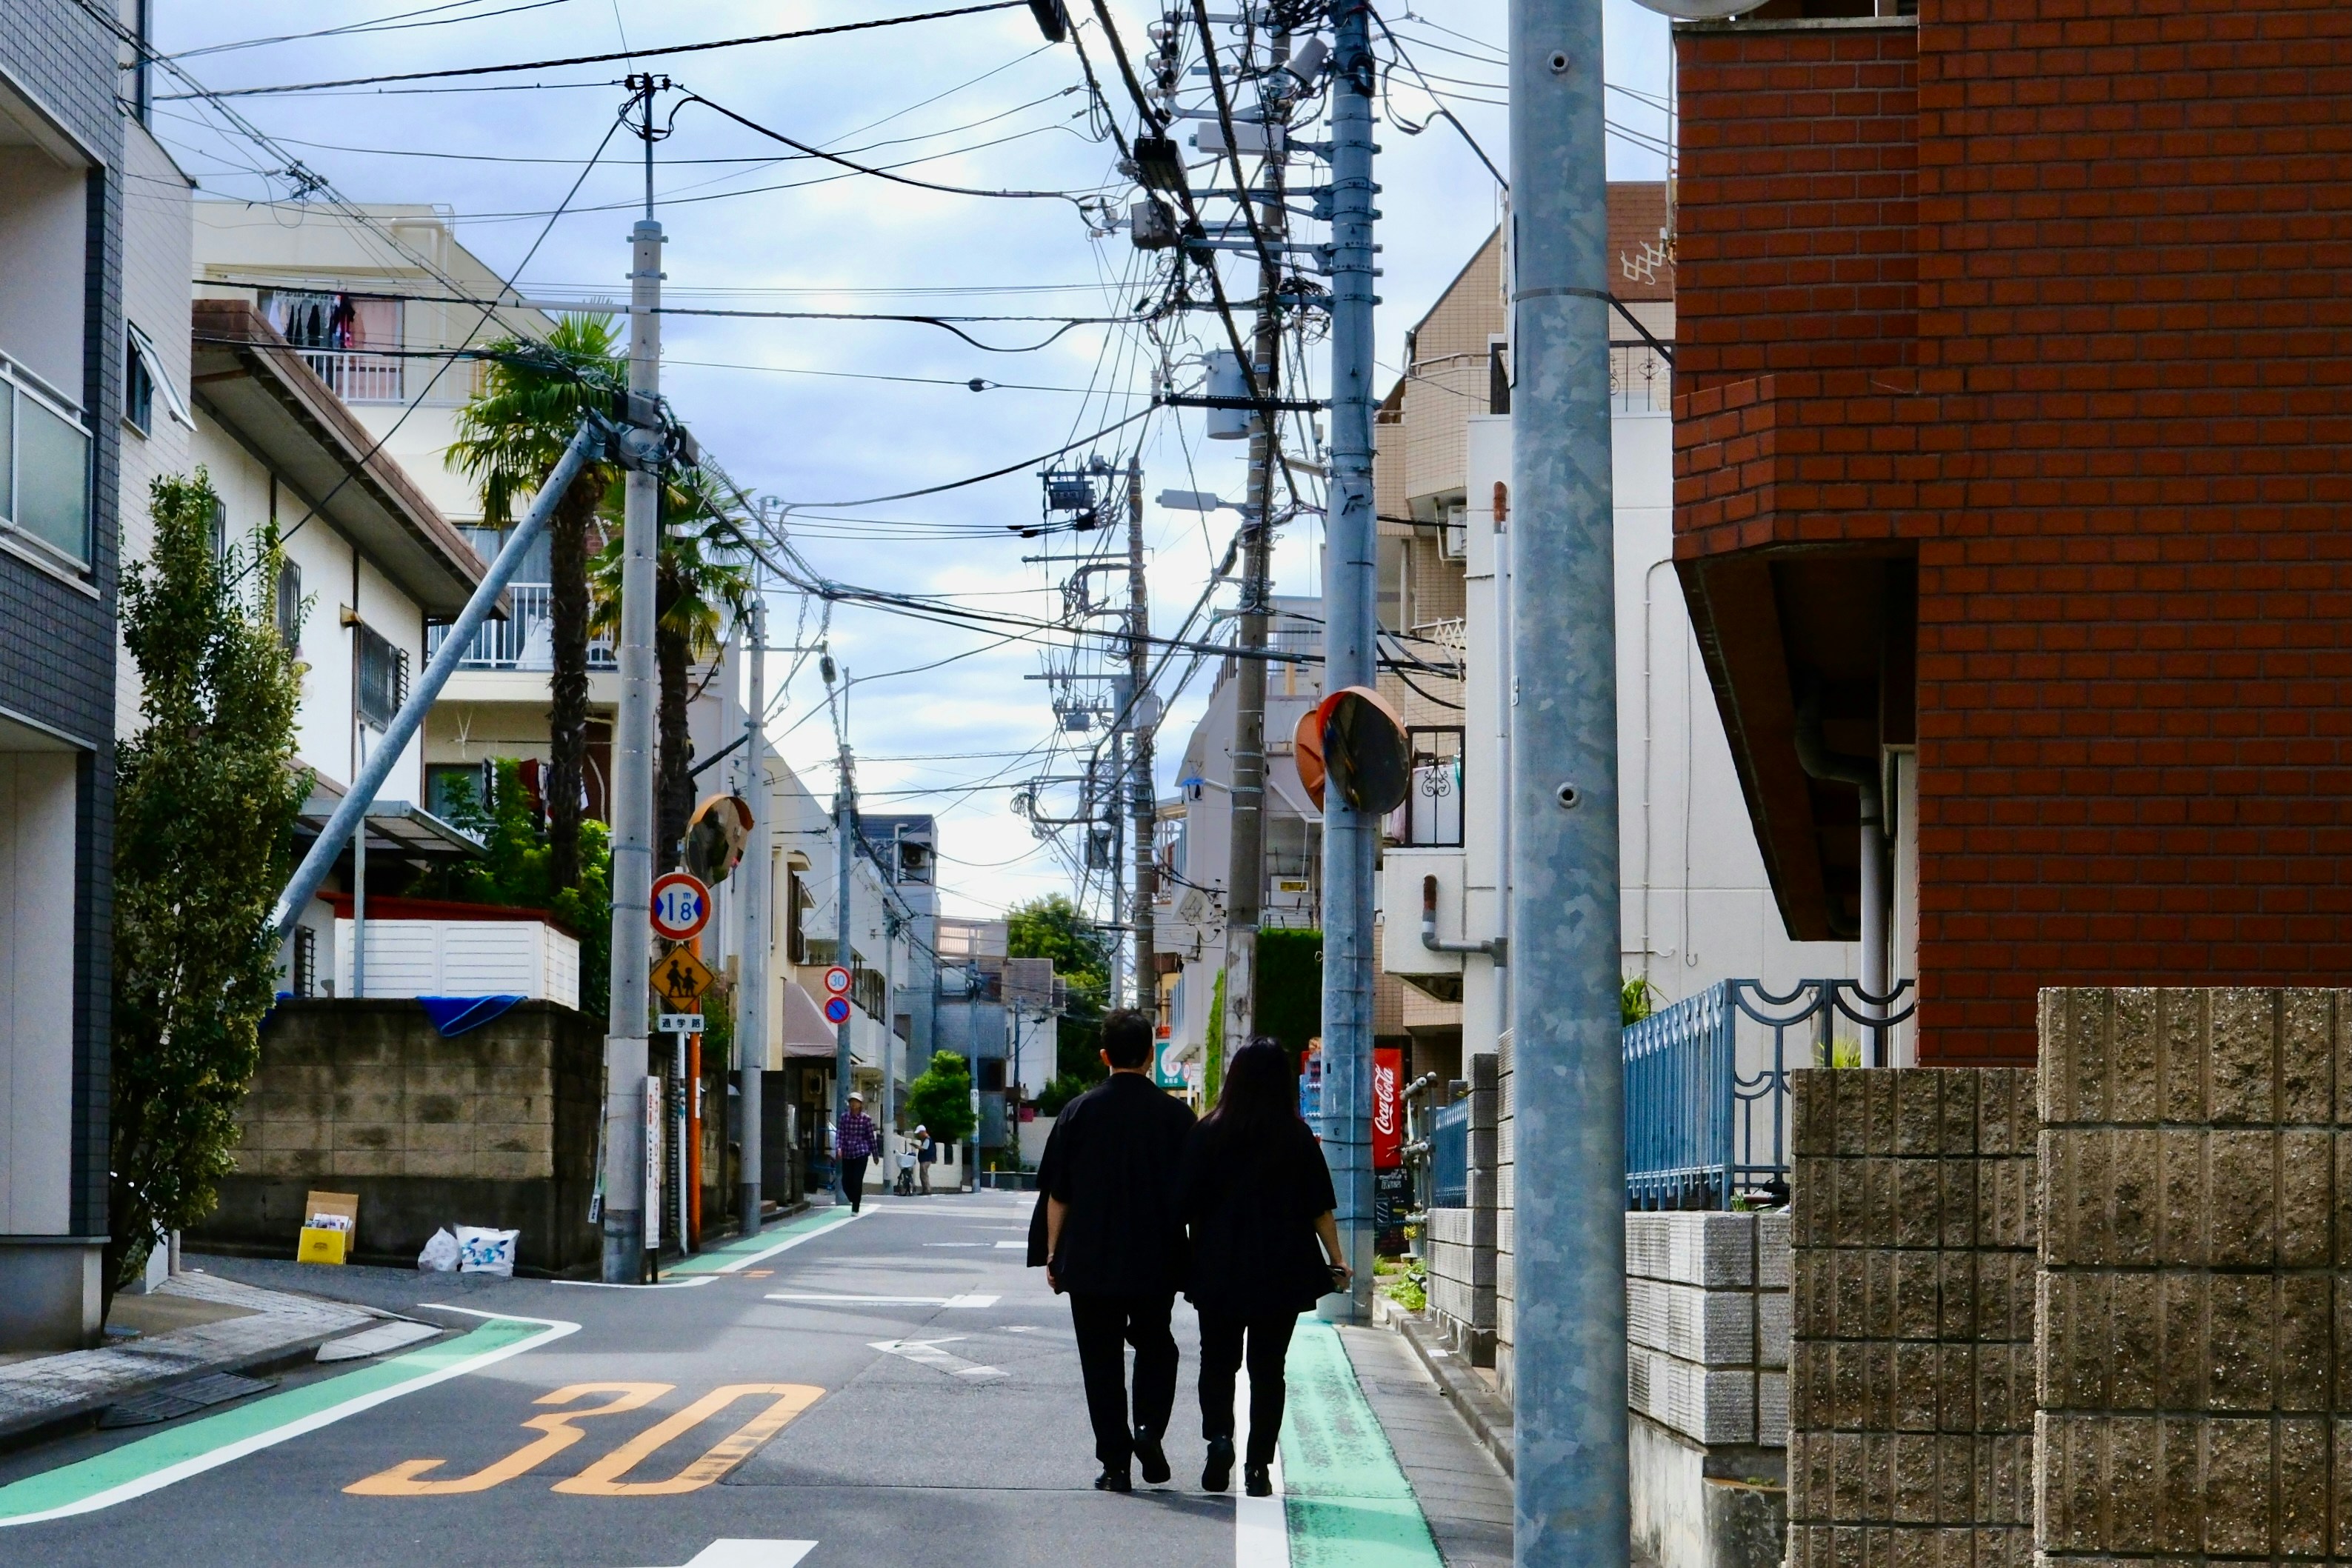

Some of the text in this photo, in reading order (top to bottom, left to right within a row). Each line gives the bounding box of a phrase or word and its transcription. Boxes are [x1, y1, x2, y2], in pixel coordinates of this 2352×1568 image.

[830, 975, 844, 987] 30
[662, 1018, 701, 1028] 通学路
[342, 1382, 827, 1495] 30
